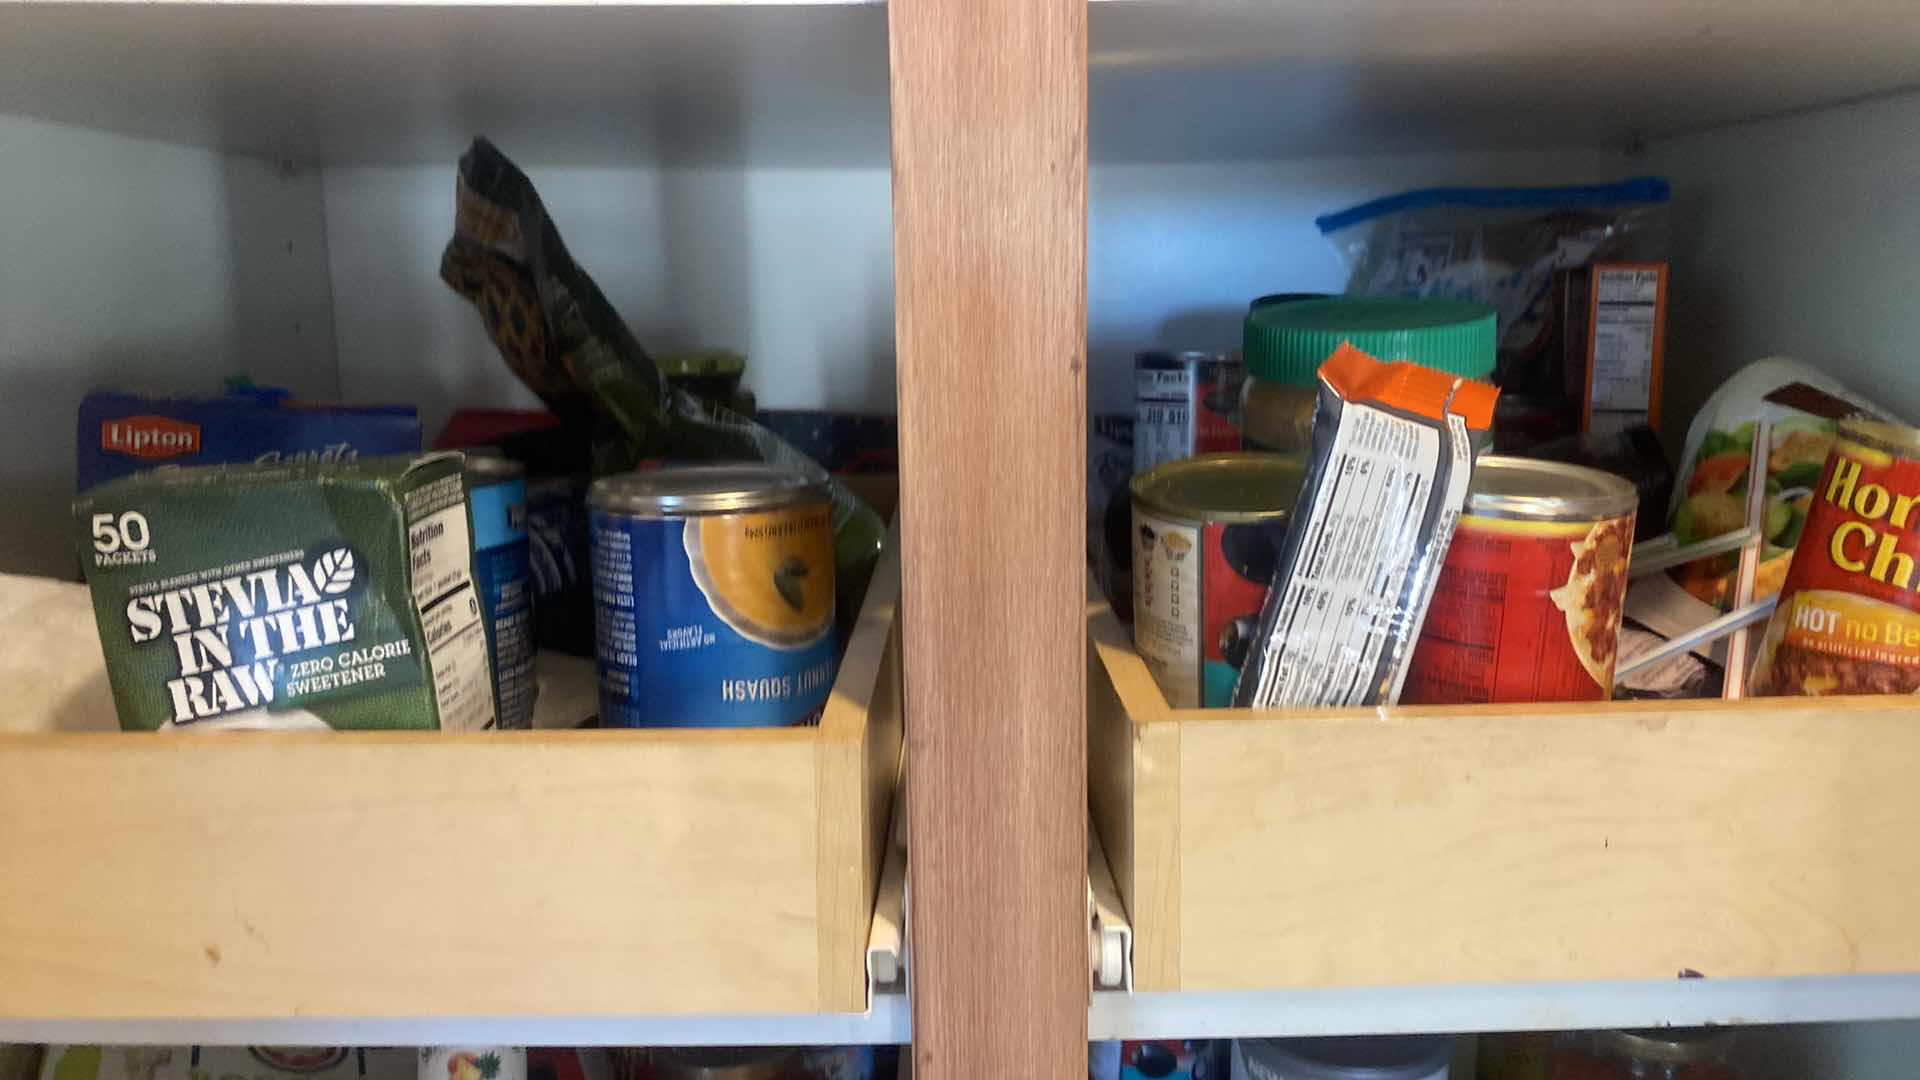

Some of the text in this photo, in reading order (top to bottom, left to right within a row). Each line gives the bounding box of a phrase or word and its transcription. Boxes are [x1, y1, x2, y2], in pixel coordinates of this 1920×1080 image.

[111, 423, 193, 449] Lipton
[92, 511, 150, 553] 50
[95, 549, 157, 567] PACKETS
[1831, 521, 1920, 593] Ch
[127, 562, 321, 643] STEVIA
[173, 599, 354, 677] IN THE
[1795, 606, 1840, 635] HOT
[1846, 620, 1877, 642] no
[290, 639, 411, 678] ZERO CALORIE
[168, 658, 279, 723] RAW
[287, 664, 385, 698] SWEETENER
[722, 675, 791, 702] SQUASH
